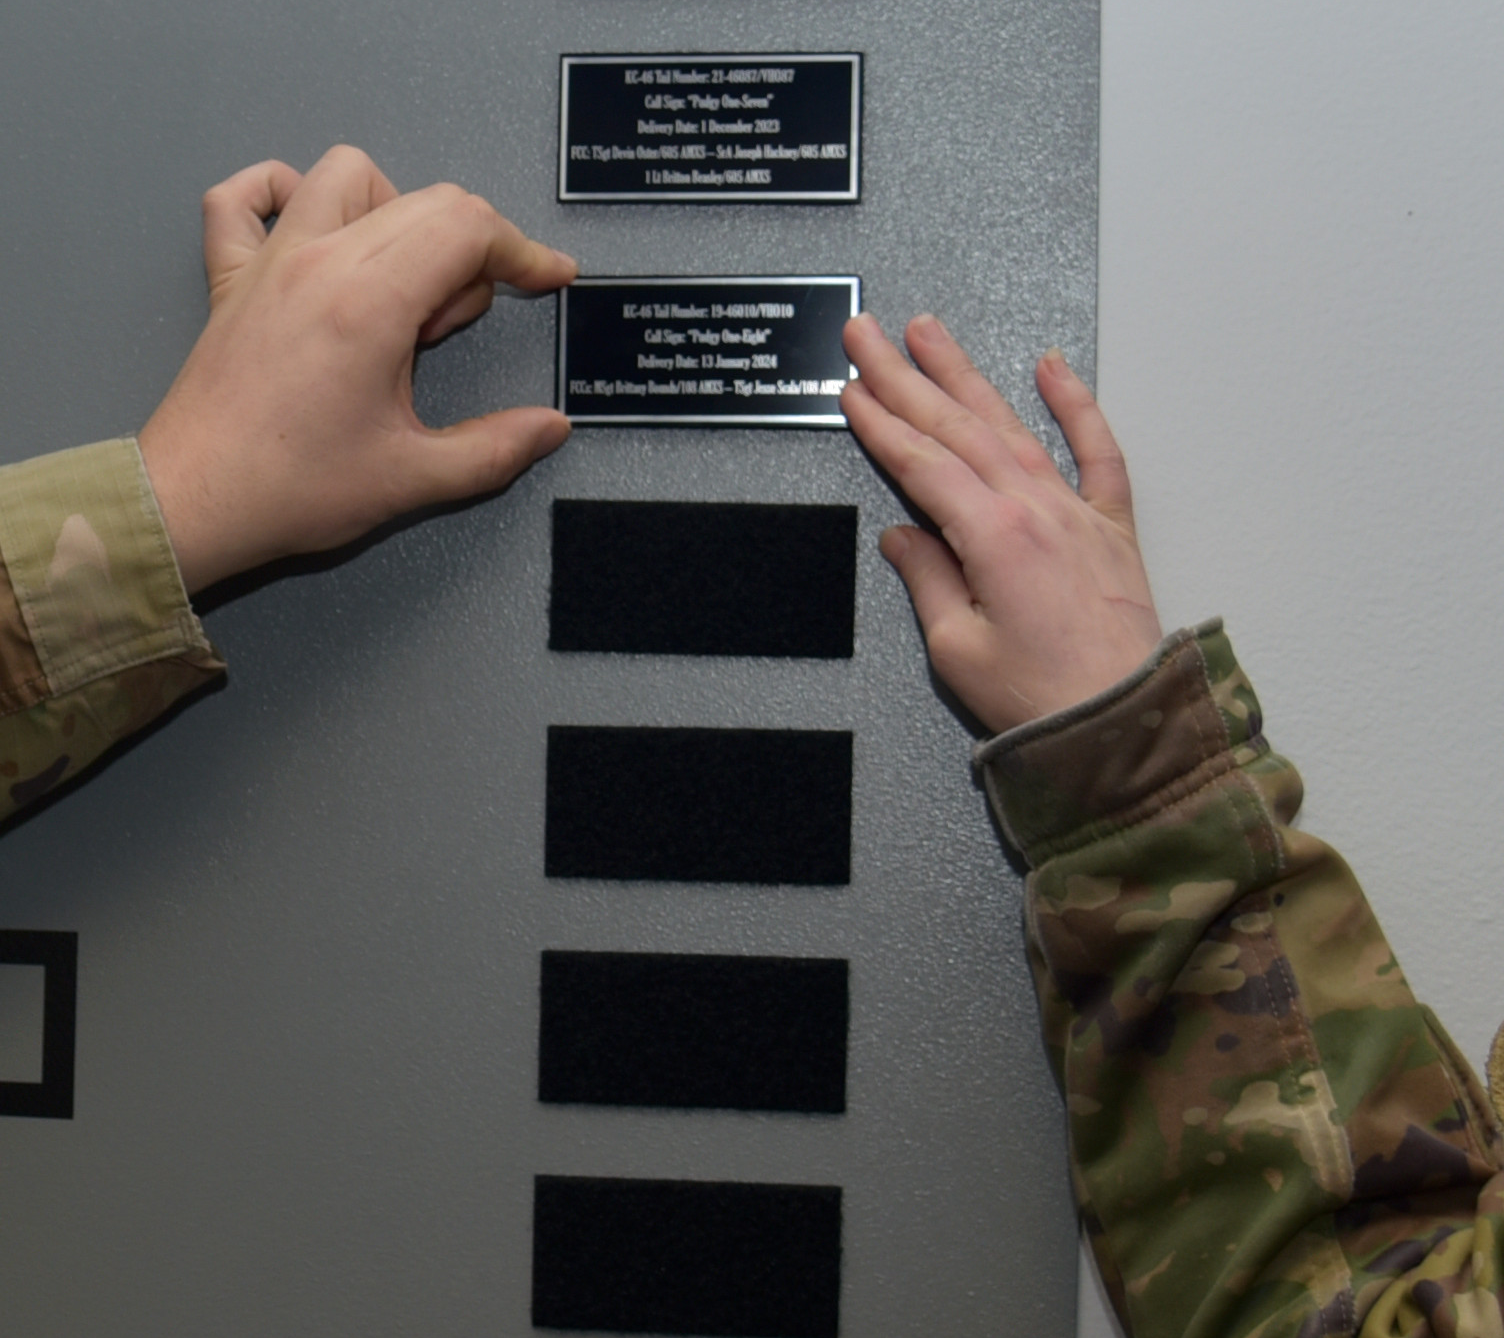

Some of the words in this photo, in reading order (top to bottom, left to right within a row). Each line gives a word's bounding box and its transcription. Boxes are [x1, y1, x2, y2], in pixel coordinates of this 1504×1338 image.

[625, 70, 654, 84] KC-46
[637, 120, 674, 136] Delivery
[708, 119, 753, 133] December
[754, 119, 781, 133] 2023
[623, 304, 652, 318] KC-46
[653, 304, 670, 318] Tail
[670, 304, 709, 318] Number:
[637, 354, 674, 370] Delivery
[675, 354, 699, 368] Date:
[714, 354, 751, 371] January
